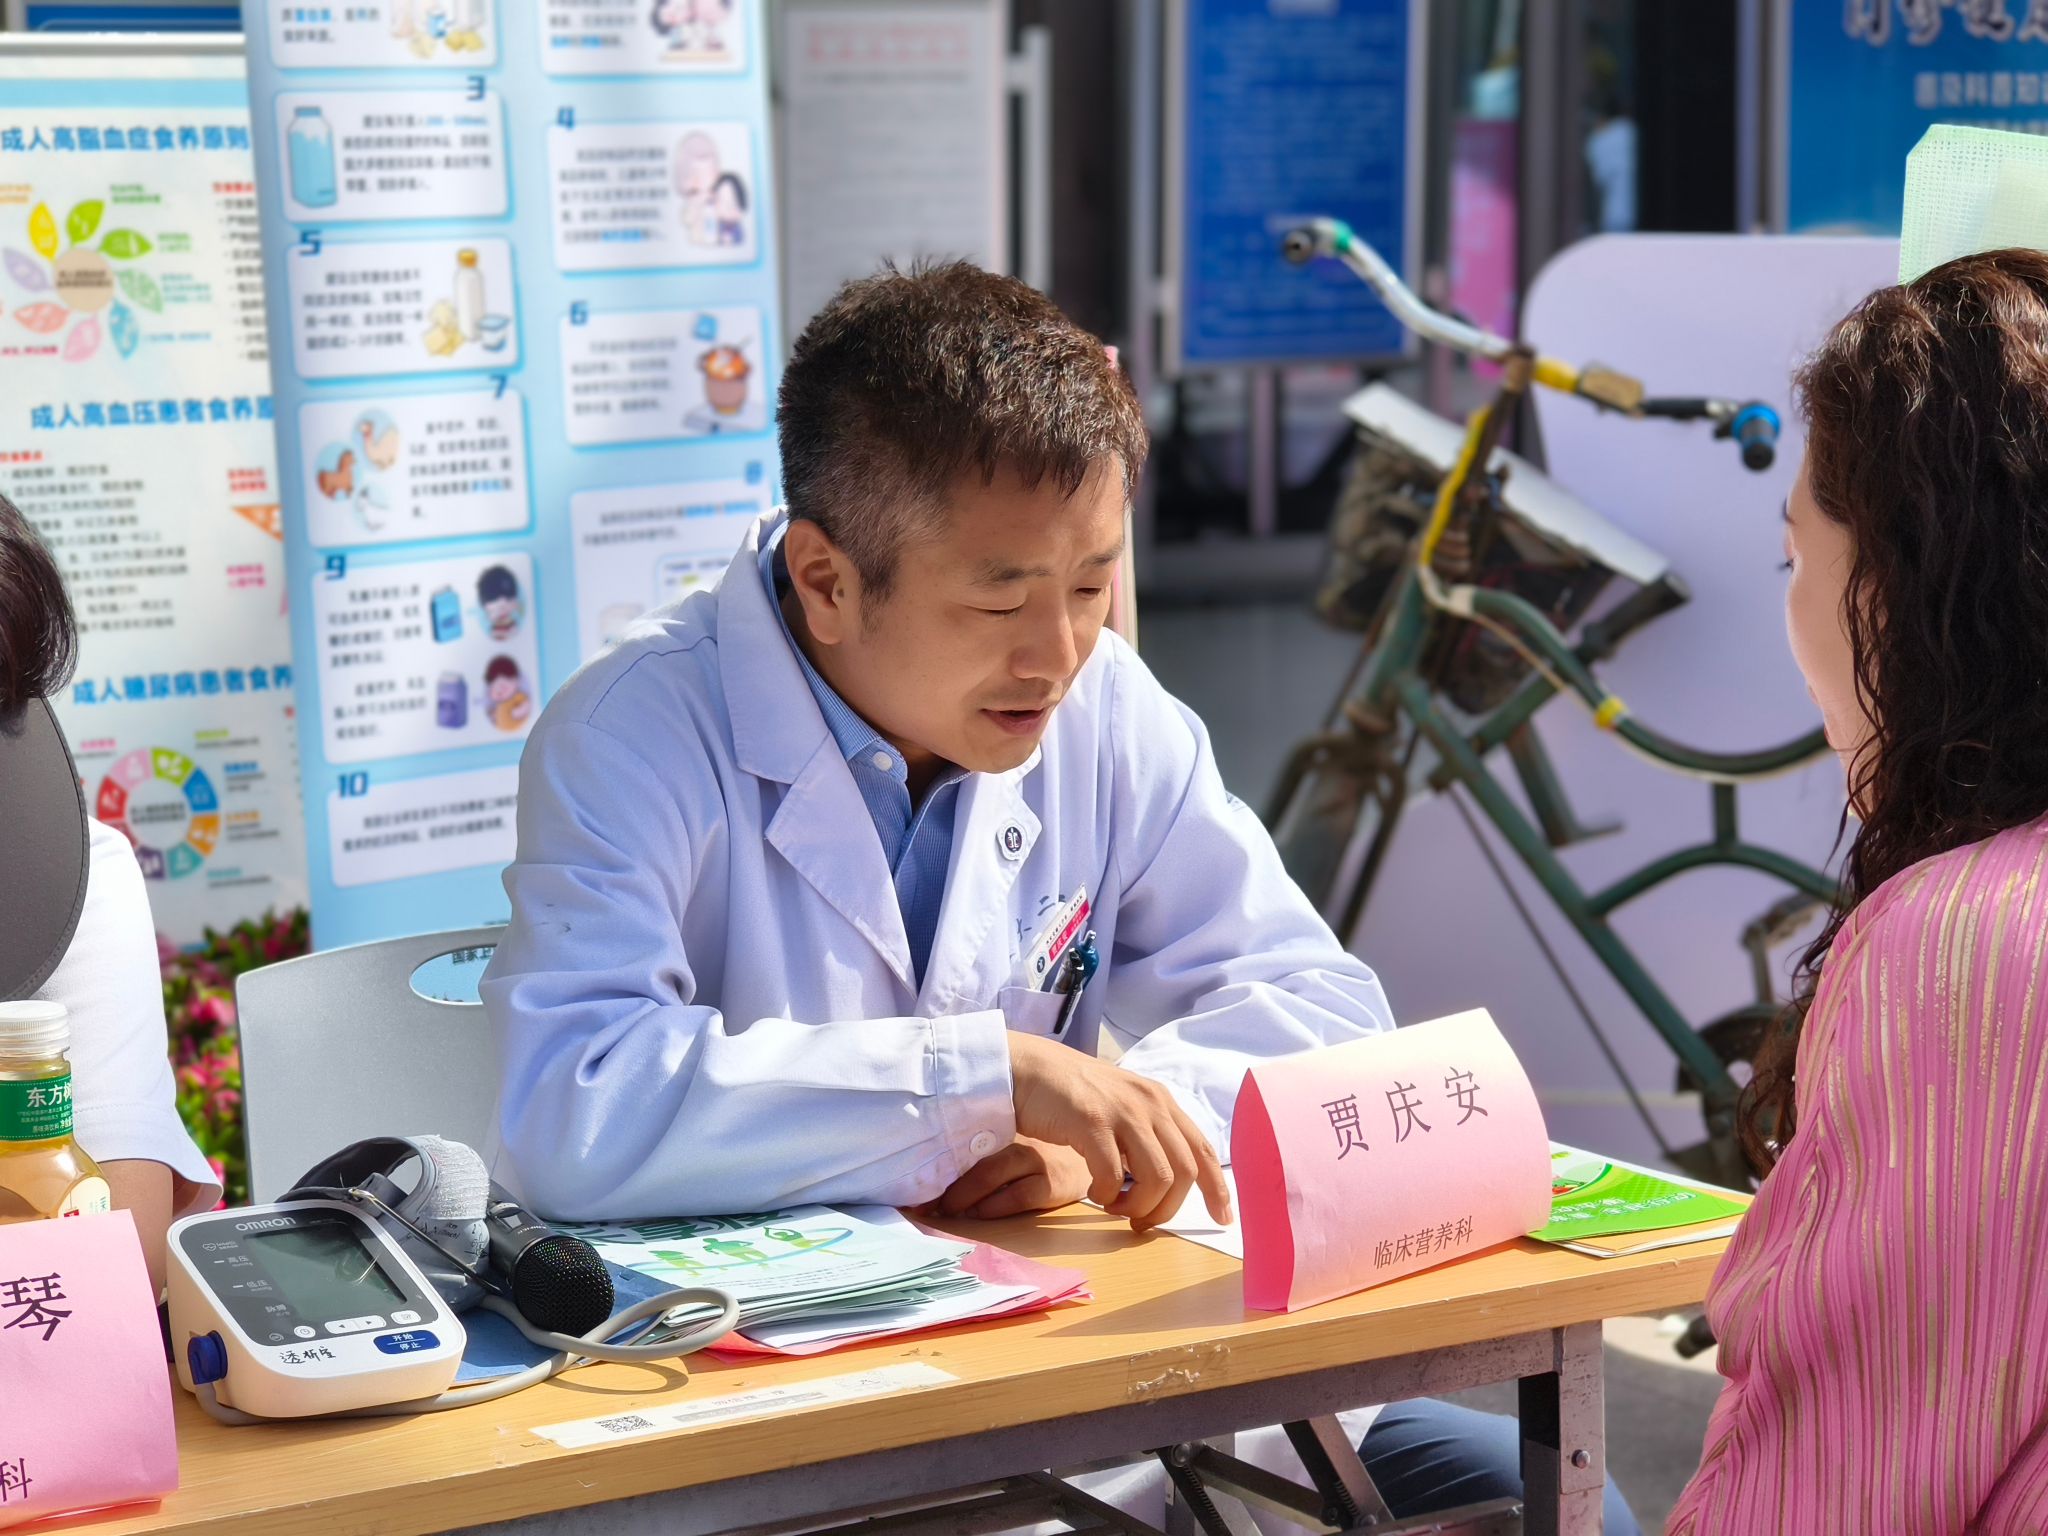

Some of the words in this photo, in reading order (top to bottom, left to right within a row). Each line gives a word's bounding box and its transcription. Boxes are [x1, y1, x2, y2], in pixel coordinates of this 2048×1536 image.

[467, 76, 486, 101] 3
[557, 106, 575, 130] 4
[300, 230, 321, 256] 5
[570, 301, 588, 326] 6
[490, 374, 508, 399] 7
[324, 555, 346, 580] 9
[337, 772, 368, 798] 10
[1321, 1066, 1488, 1160] 贾庆安
[235, 1216, 296, 1231] OMRON
[1373, 1216, 1472, 1270] 临床营养科
[0, 1272, 73, 1341] 琴
[392, 1333, 413, 1342] 开始
[400, 1343, 421, 1351] 停止
[0, 1457, 33, 1502] 科
